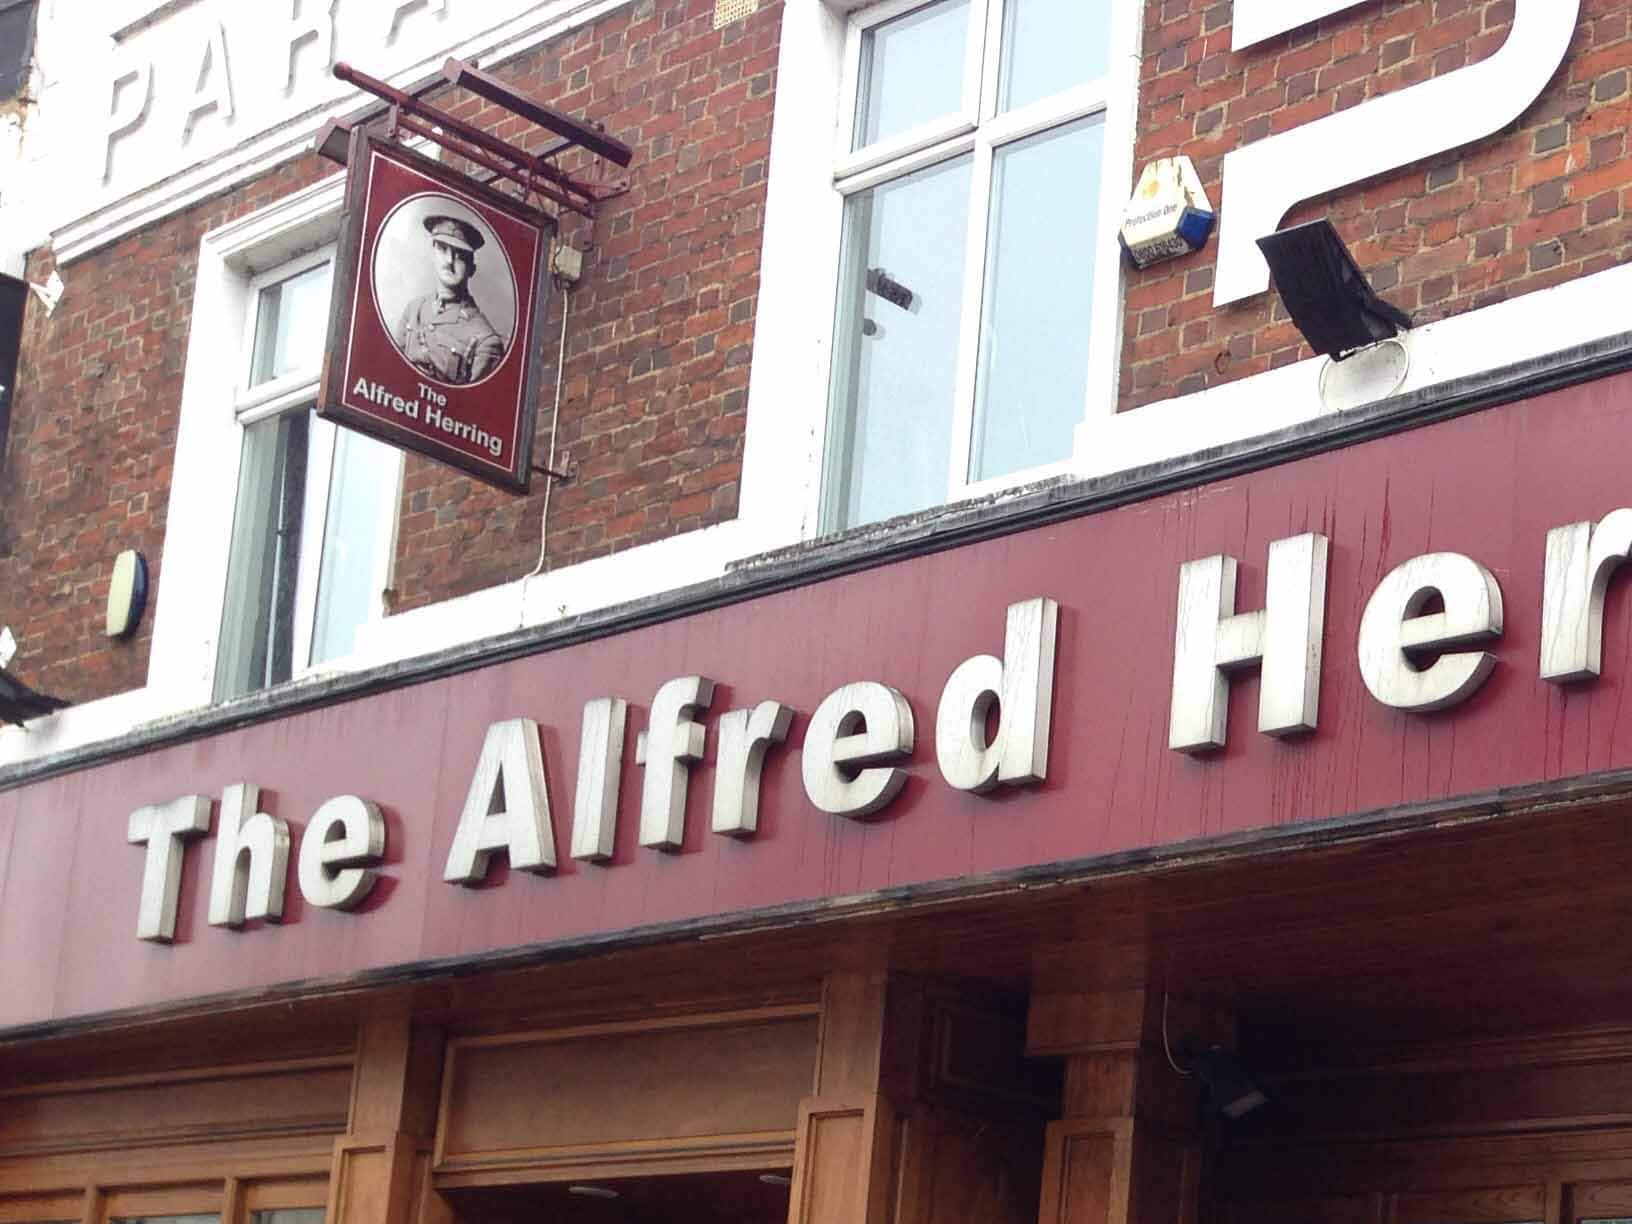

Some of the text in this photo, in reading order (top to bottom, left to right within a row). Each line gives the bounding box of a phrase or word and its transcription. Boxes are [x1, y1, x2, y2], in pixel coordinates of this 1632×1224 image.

[352, 376, 503, 457] Alfred Herring
[417, 382, 448, 407] The
[128, 783, 386, 944] The
[443, 597, 1059, 887] Alfred
